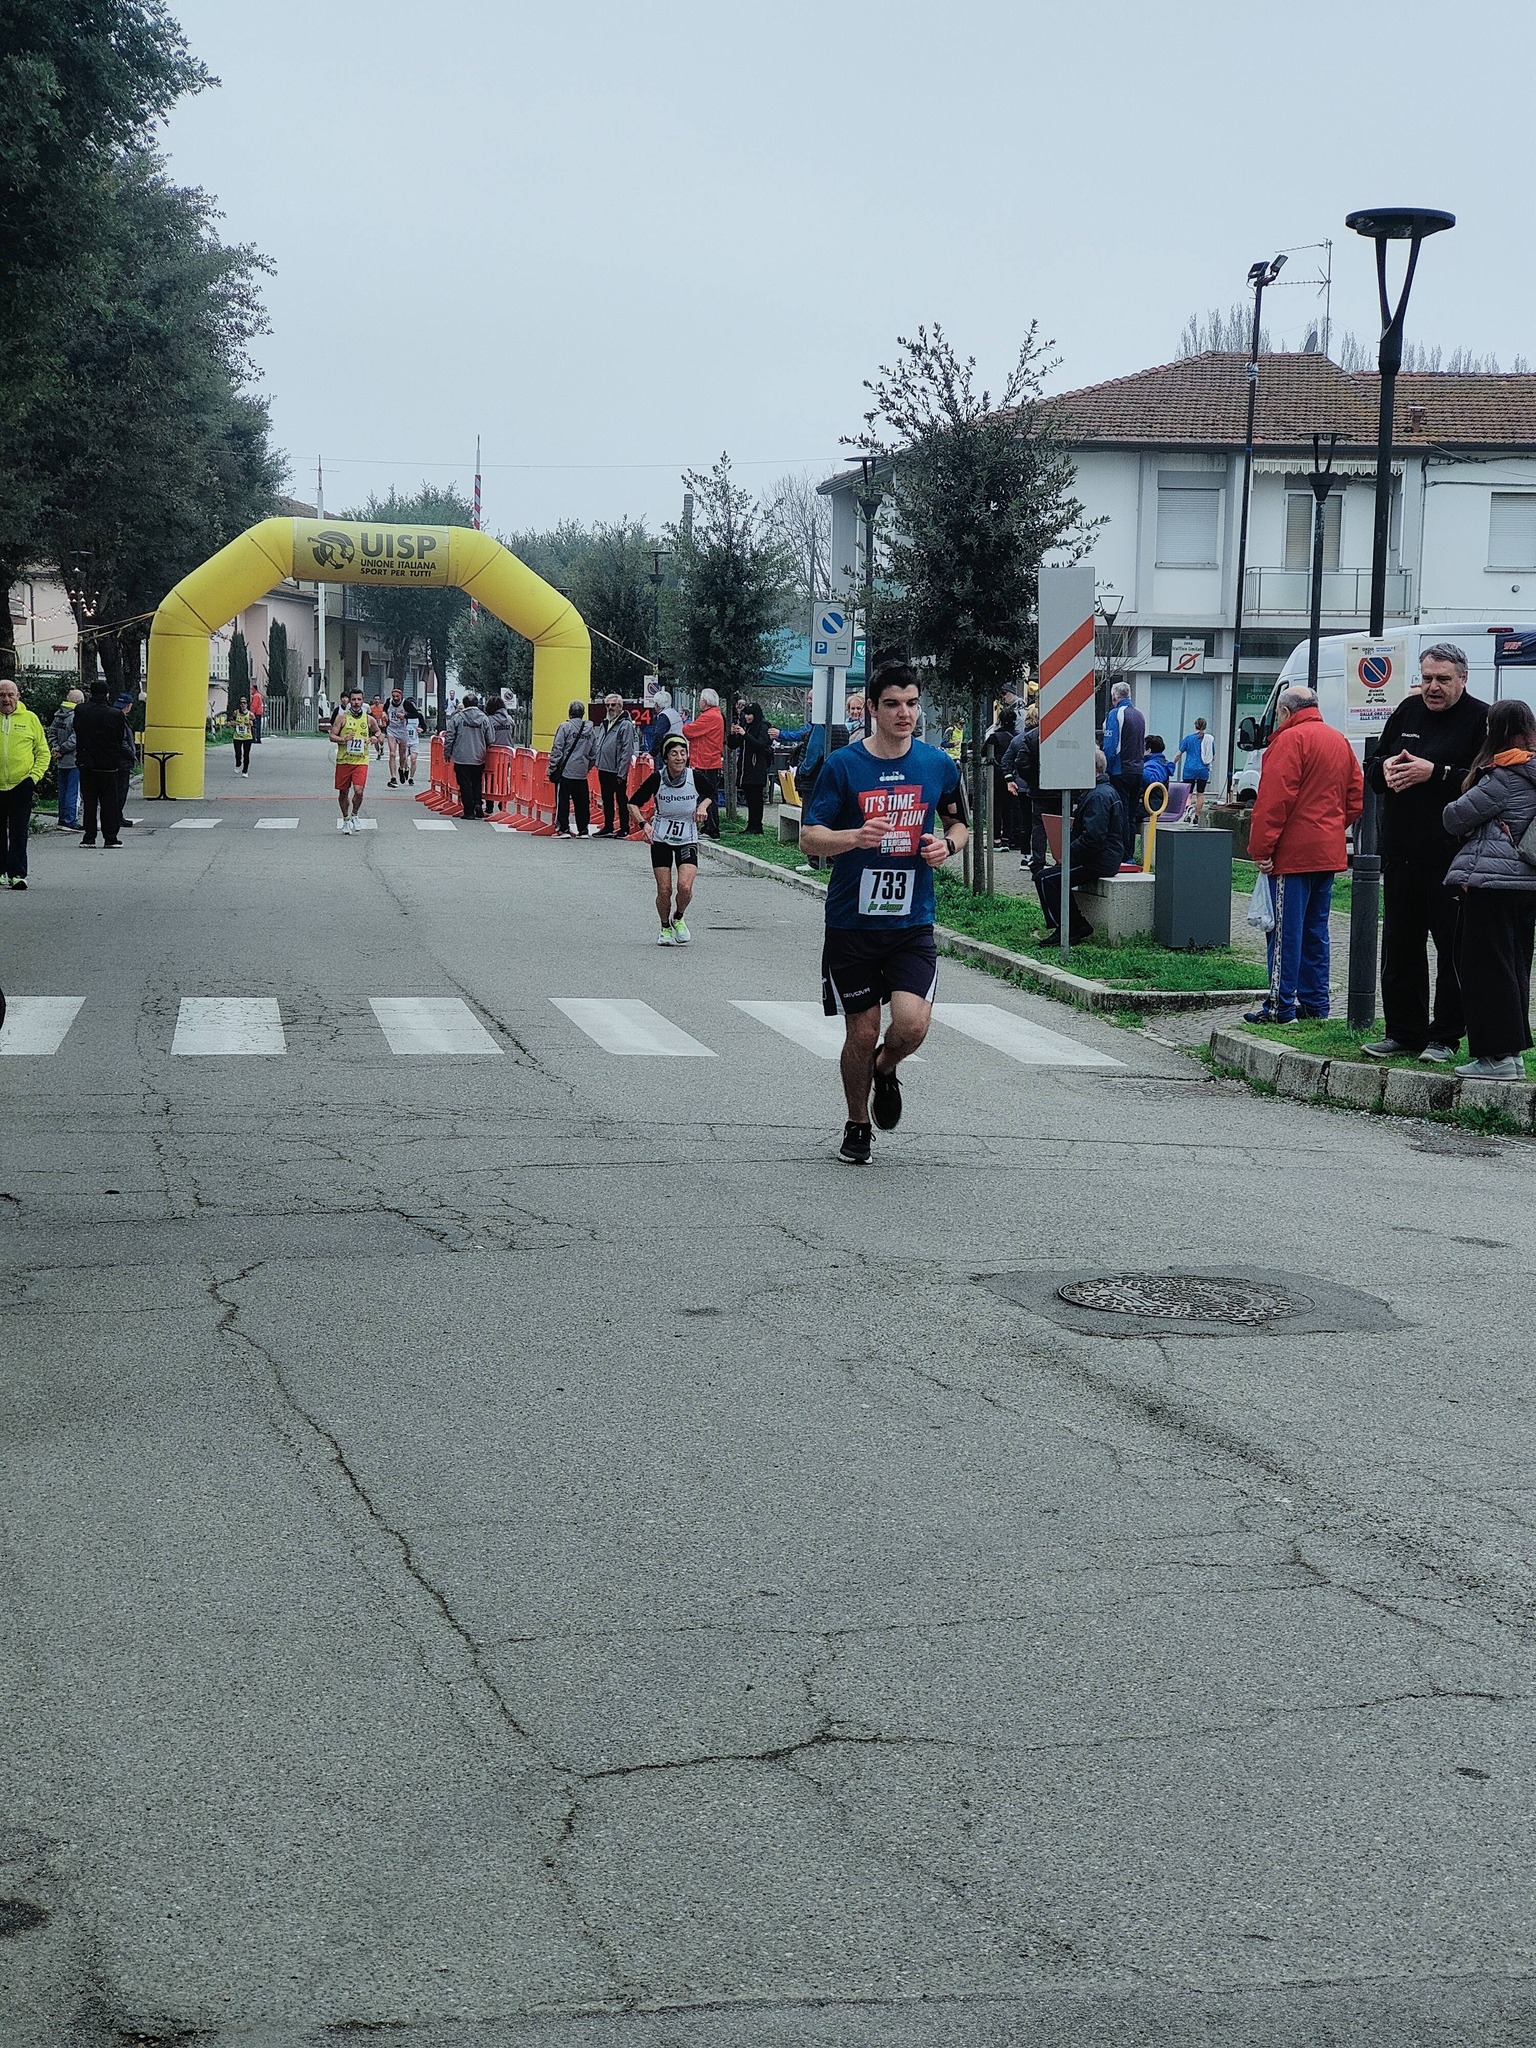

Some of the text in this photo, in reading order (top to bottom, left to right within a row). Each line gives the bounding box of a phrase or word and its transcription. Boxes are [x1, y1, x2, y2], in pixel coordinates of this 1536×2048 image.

[361, 533, 436, 559] UISP
[360, 568, 387, 576] SPORT
[390, 569, 406, 577] PER
[361, 559, 436, 569] UNIONE ITALIANA
[864, 793, 915, 814] IT'S TIME
[899, 810, 926, 827] RUN
[870, 871, 907, 900] 733
